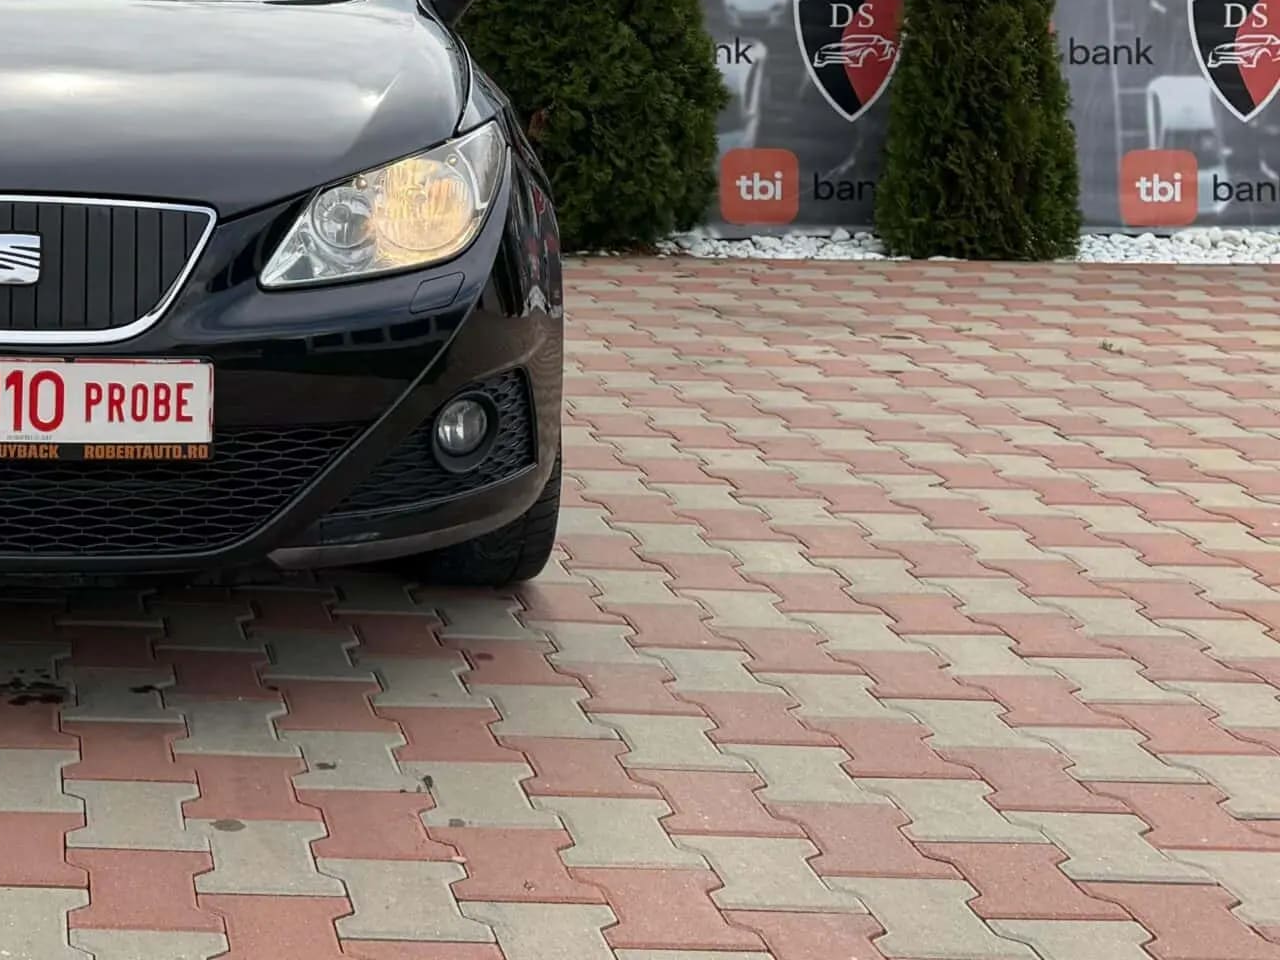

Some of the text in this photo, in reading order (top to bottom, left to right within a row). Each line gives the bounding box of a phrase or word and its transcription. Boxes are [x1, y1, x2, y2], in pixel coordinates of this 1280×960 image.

[830, 3, 875, 29] DS
[1224, 2, 1269, 29] DS
[713, 36, 753, 65] nk
[1069, 36, 1154, 66] bank
[736, 170, 878, 201] tbi ban
[1136, 171, 1277, 203] tbi ban
[84, 381, 194, 423] PROBE
[83, 444, 209, 460] ROBERTAUTO.RO
